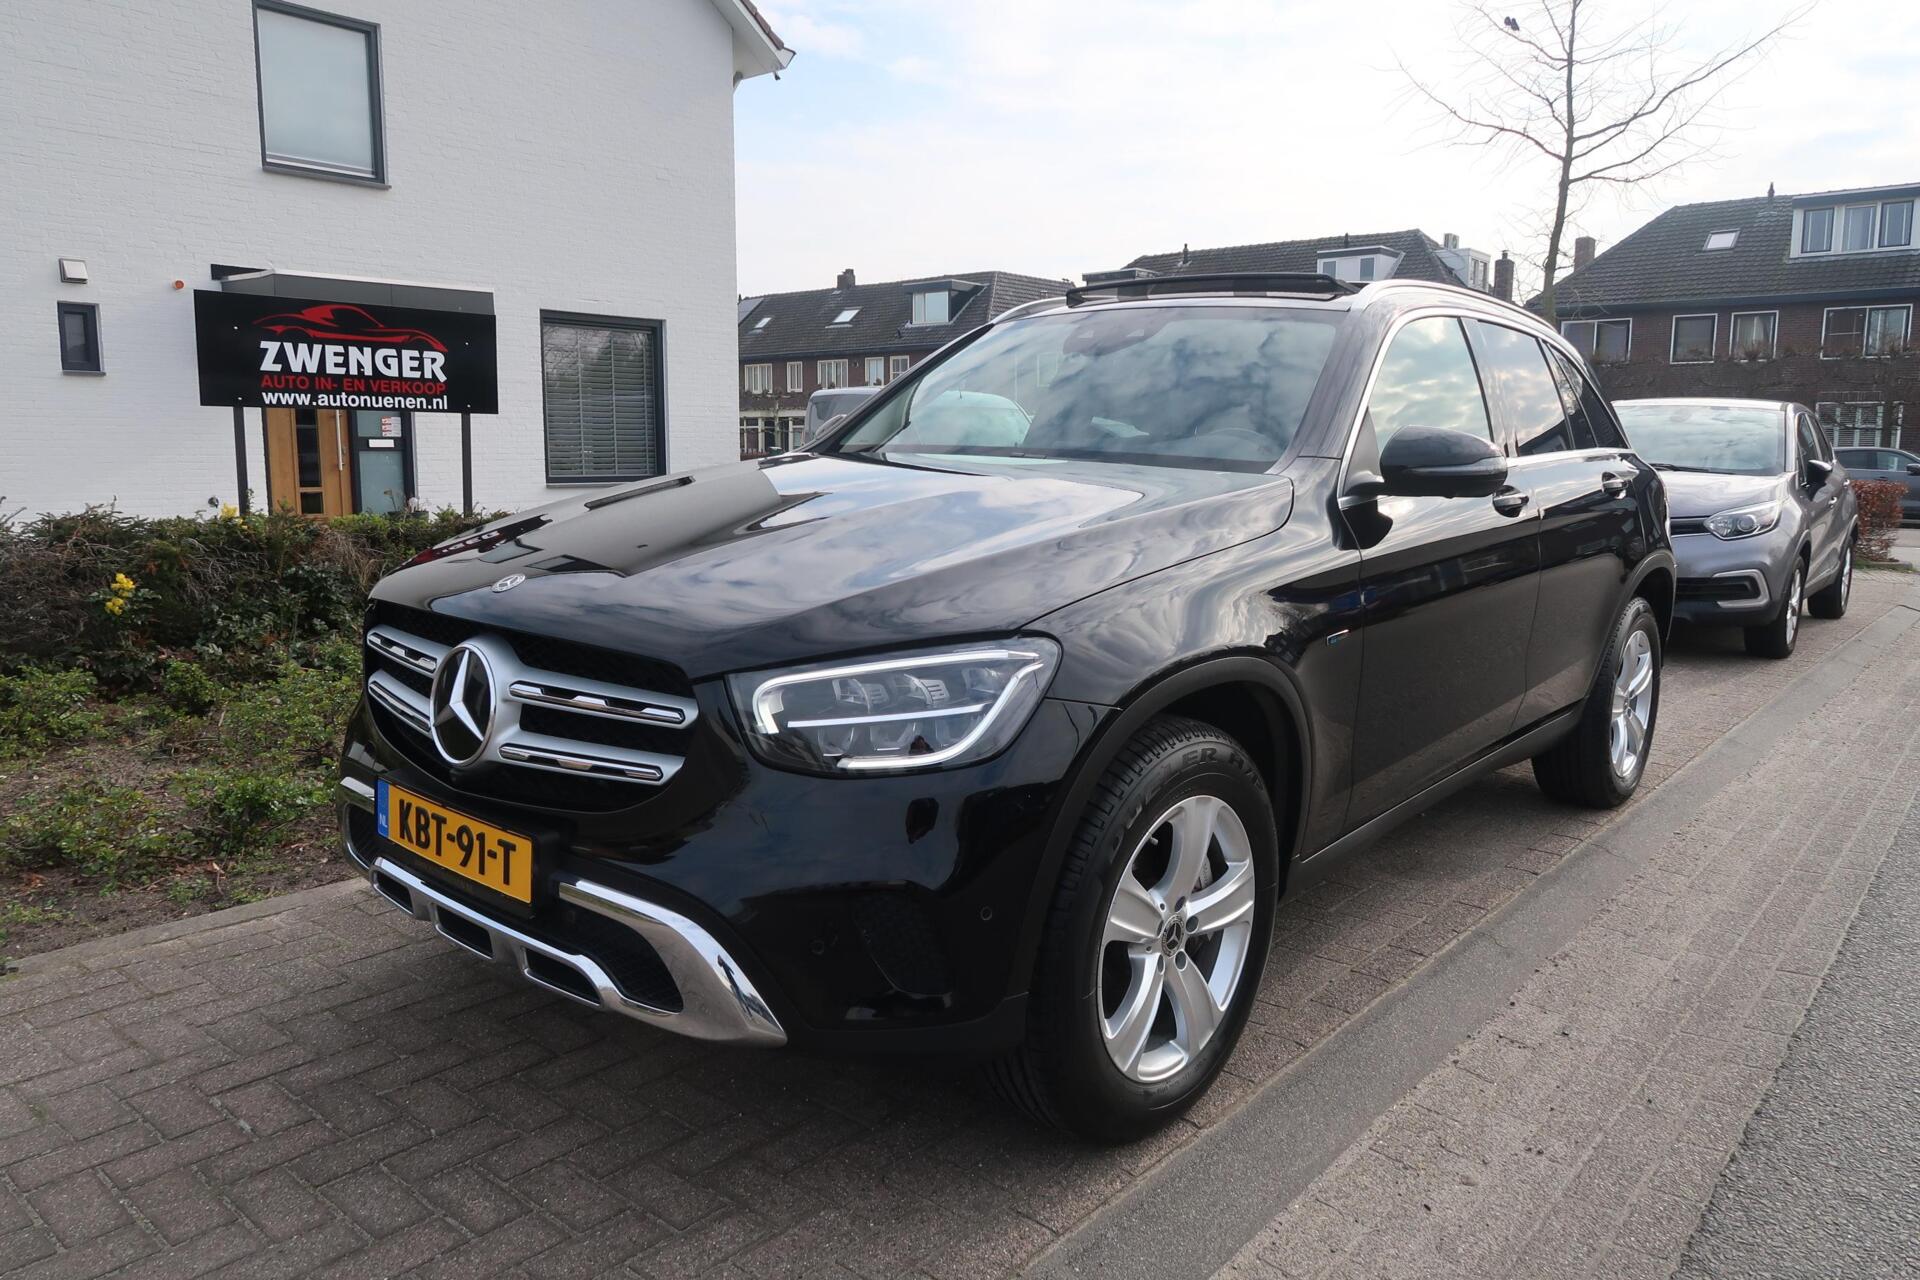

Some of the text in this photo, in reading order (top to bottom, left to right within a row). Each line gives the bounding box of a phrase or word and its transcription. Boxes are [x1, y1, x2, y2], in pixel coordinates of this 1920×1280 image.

[260, 341, 447, 382] ZWENGER
[261, 375, 446, 395] AUTO IN- EN VERKOOP
[262, 392, 448, 409] www.autonuenen.nl
[379, 813, 388, 828] NL
[398, 799, 517, 886] KBT-91-T
